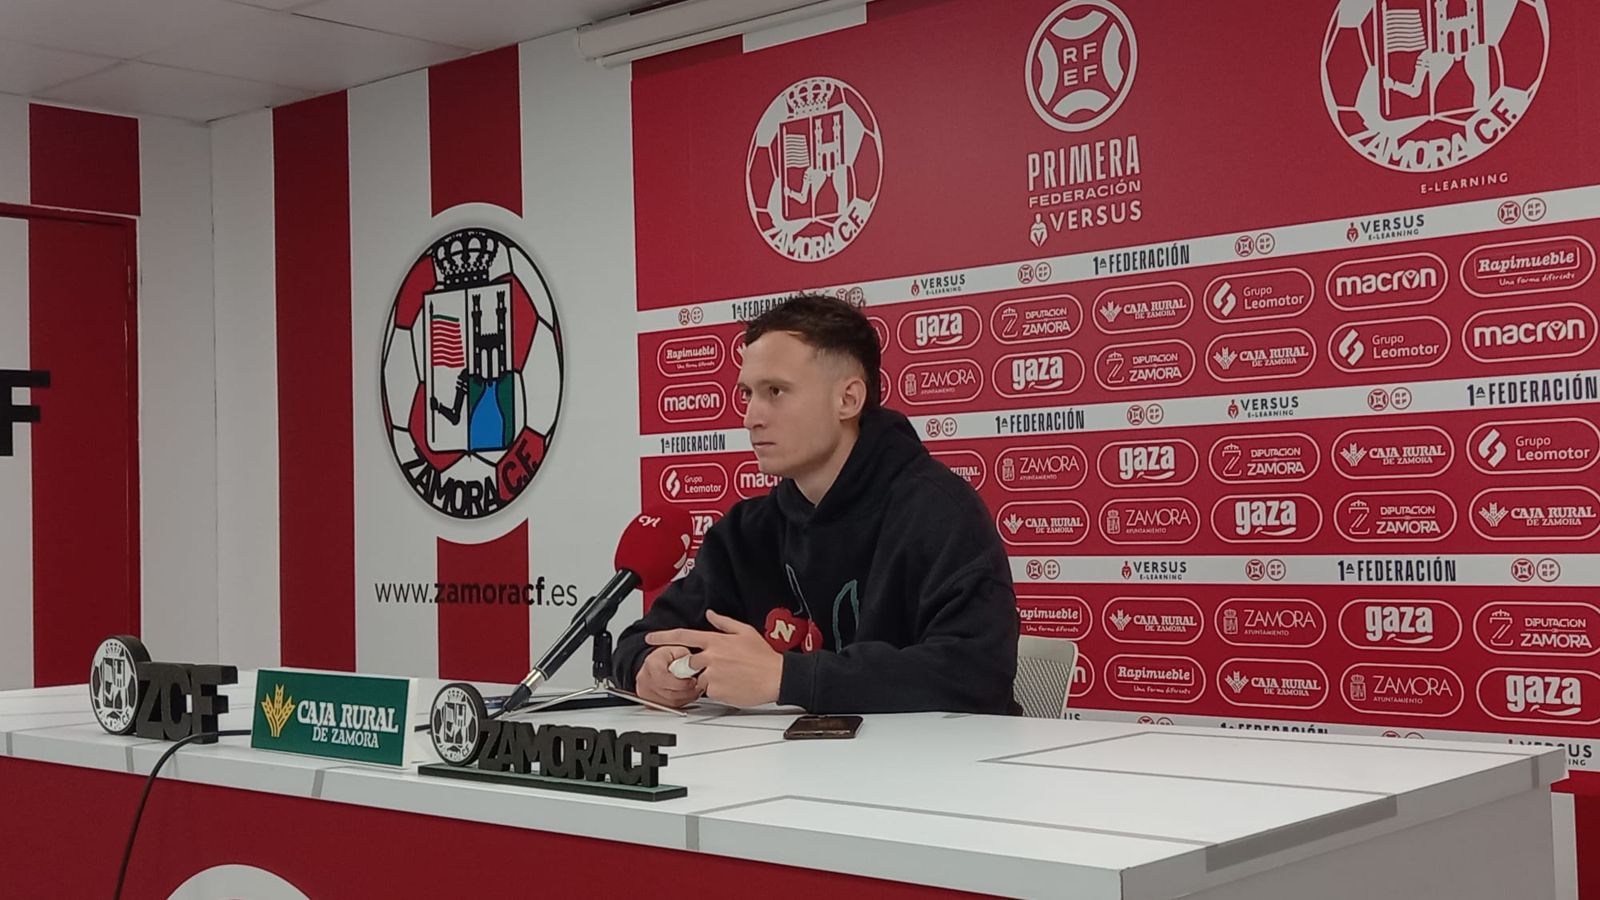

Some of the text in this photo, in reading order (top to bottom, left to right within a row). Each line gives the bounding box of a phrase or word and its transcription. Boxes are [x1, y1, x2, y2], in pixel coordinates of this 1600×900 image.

[1357, 97, 1517, 170] ZAMORA C.F.
[1027, 135, 1140, 191] PRIMERA
[1420, 172, 1509, 194] E-LEARNING
[1028, 179, 1142, 208] FEDERACIÓN
[1049, 200, 1142, 231] VERSUS
[1361, 214, 1425, 234] VERSUS
[763, 206, 865, 260] ZAMORA C.F.
[1109, 243, 1190, 273] FEDERACIÓN
[1478, 250, 1575, 274] Rapimueble
[921, 274, 966, 289] VERSUS
[1244, 285, 1273, 298] Grupo
[1336, 268, 1436, 296] macron
[1244, 293, 1304, 310] Leomotor
[915, 312, 963, 346] gaza
[1022, 321, 1071, 336] ZAMORA
[1474, 318, 1585, 347] macron
[1372, 334, 1404, 346] Grupo
[1239, 346, 1308, 362] CAJA RURAL
[1372, 343, 1439, 359] Leomotor
[921, 369, 976, 387] ZAMORA
[1012, 356, 1064, 390] gaza
[1129, 367, 1182, 381] ZAMORA
[1488, 373, 1598, 405] FEDERACIÓN
[664, 393, 720, 411] macron
[1241, 396, 1299, 412] VERSUS
[1010, 409, 1085, 433] FEDERACIÓN
[671, 432, 725, 453] FEDERACIÓN
[1369, 444, 1446, 459] CAJA RURAL
[1516, 435, 1551, 448] Grupo
[1119, 445, 1175, 480] gaza
[1516, 446, 1591, 462] Leomotor
[1020, 456, 1079, 473] ZAMORA
[1247, 461, 1305, 476] ZAMORA
[402, 439, 539, 517] ZAMORA C.F.
[684, 475, 703, 484] Grupo
[685, 484, 721, 493] Leomotor
[1126, 508, 1191, 526] ZAMORA
[1235, 500, 1296, 536] gaza
[1511, 506, 1596, 520] CAJA RURAL
[1541, 516, 1582, 526] ZAMORA
[1376, 520, 1440, 535] ZAMORA
[1133, 561, 1187, 573] VERSUS
[1358, 557, 1456, 582] FEDERACIÓN
[374, 576, 578, 608] www.zamoracf.es
[1016, 607, 1079, 620] apimueble
[1134, 615, 1197, 626] CAJA RURAL
[1244, 609, 1317, 629] ZAMORA
[770, 619, 796, 642] N
[1365, 606, 1433, 642] gaza
[1521, 633, 1592, 648] ZAMORA
[1118, 666, 1190, 682] Rapimueble
[1251, 677, 1321, 690] CAJA RURAL
[1373, 675, 1453, 697] ZAMORA
[1506, 675, 1581, 713] gaza
[136, 661, 238, 744] ZCF
[298, 700, 399, 733] CAJA RURAL
[312, 727, 379, 748] DE ZAMORA
[478, 719, 677, 787] ZAMORACF
